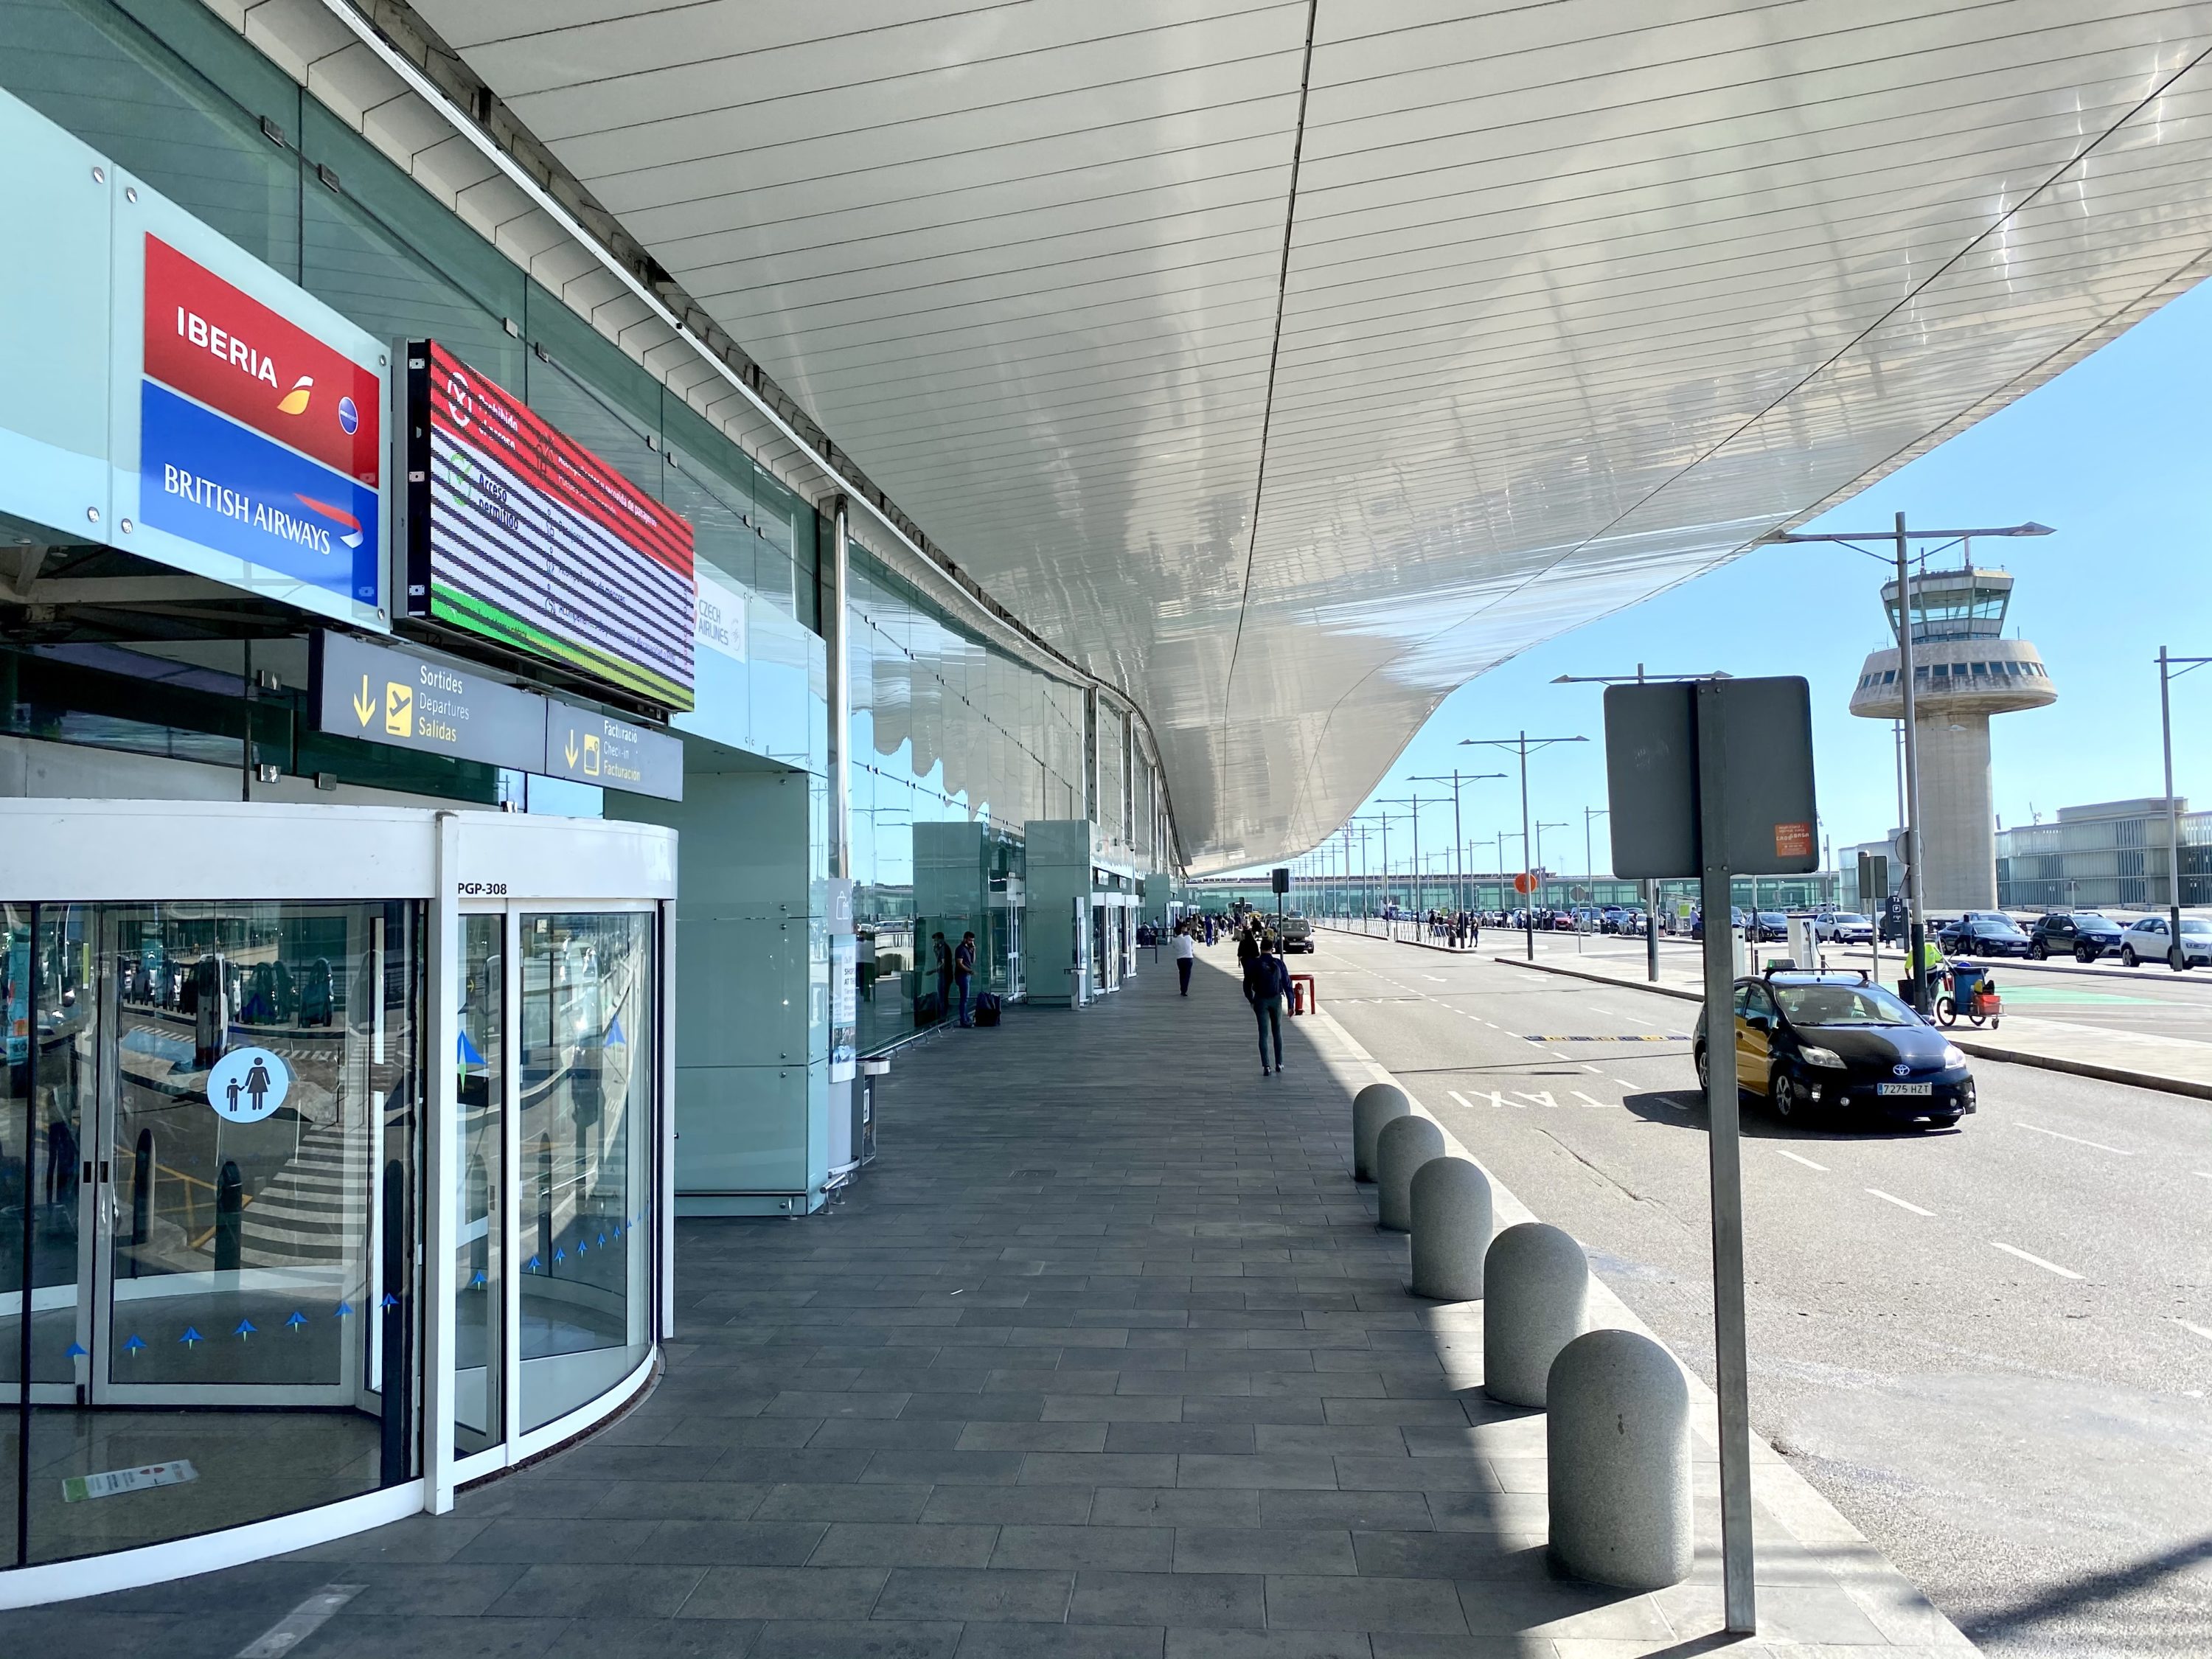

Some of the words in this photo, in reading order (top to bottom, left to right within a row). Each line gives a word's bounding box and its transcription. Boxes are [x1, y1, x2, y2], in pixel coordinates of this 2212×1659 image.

[178, 306, 278, 389] IBERIA
[164, 463, 248, 524] BRITISH
[254, 503, 330, 555] AIRWAYS
[699, 599, 720, 625] CZECH
[698, 618, 728, 646] AIRLINES
[420, 664, 463, 694] Sortides
[420, 692, 470, 720] Departures
[419, 716, 456, 742] Salidas
[604, 720, 638, 743] Facturació
[603, 740, 629, 759] Chec-in
[604, 759, 641, 782] Facturación
[458, 883, 507, 894] PGP-308
[1447, 1091, 1621, 1108] TAXI
[1884, 1085, 1907, 1093] 7275
[1911, 1085, 1929, 1093] HZT
